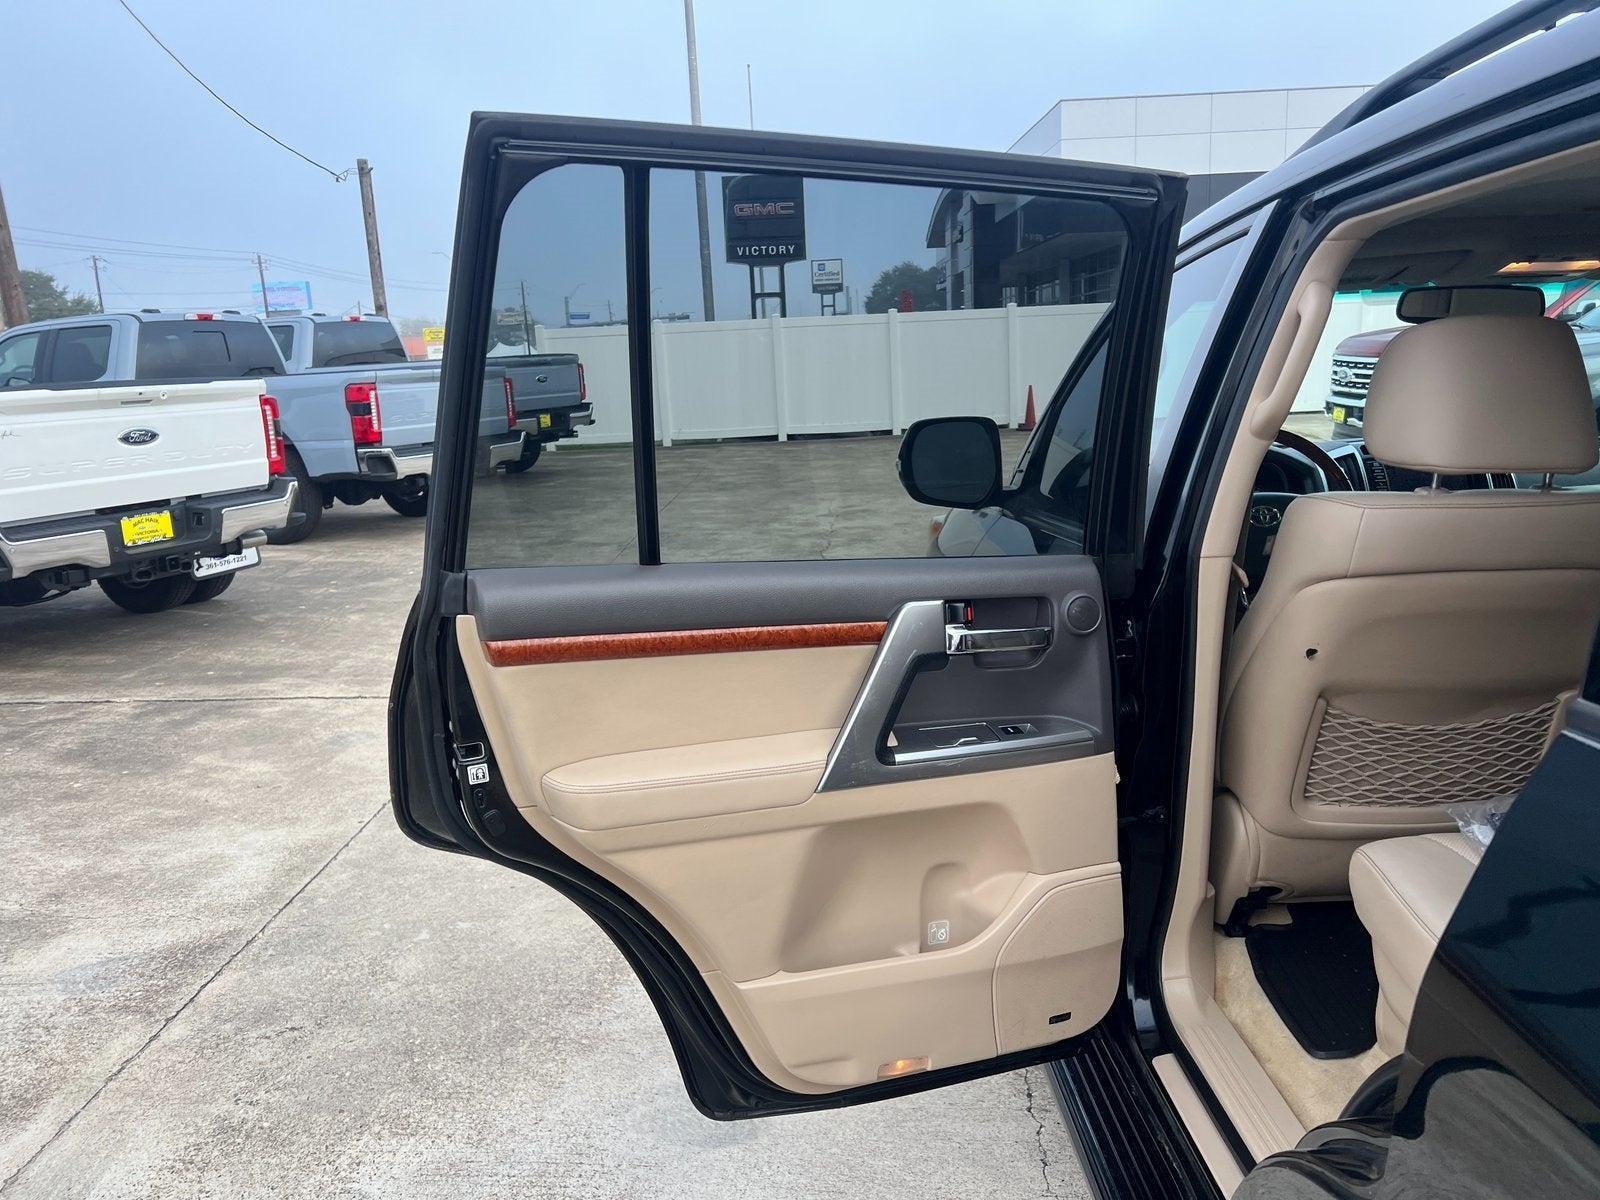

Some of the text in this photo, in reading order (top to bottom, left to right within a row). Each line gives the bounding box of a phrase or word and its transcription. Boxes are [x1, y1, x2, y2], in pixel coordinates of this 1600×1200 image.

[734, 202, 795, 217] GMC
[736, 245, 796, 256] VICTORY
[128, 430, 152, 443] Ford
[3, 443, 256, 481] SUPER DUTY
[205, 555, 248, 570] 361-576-1221
